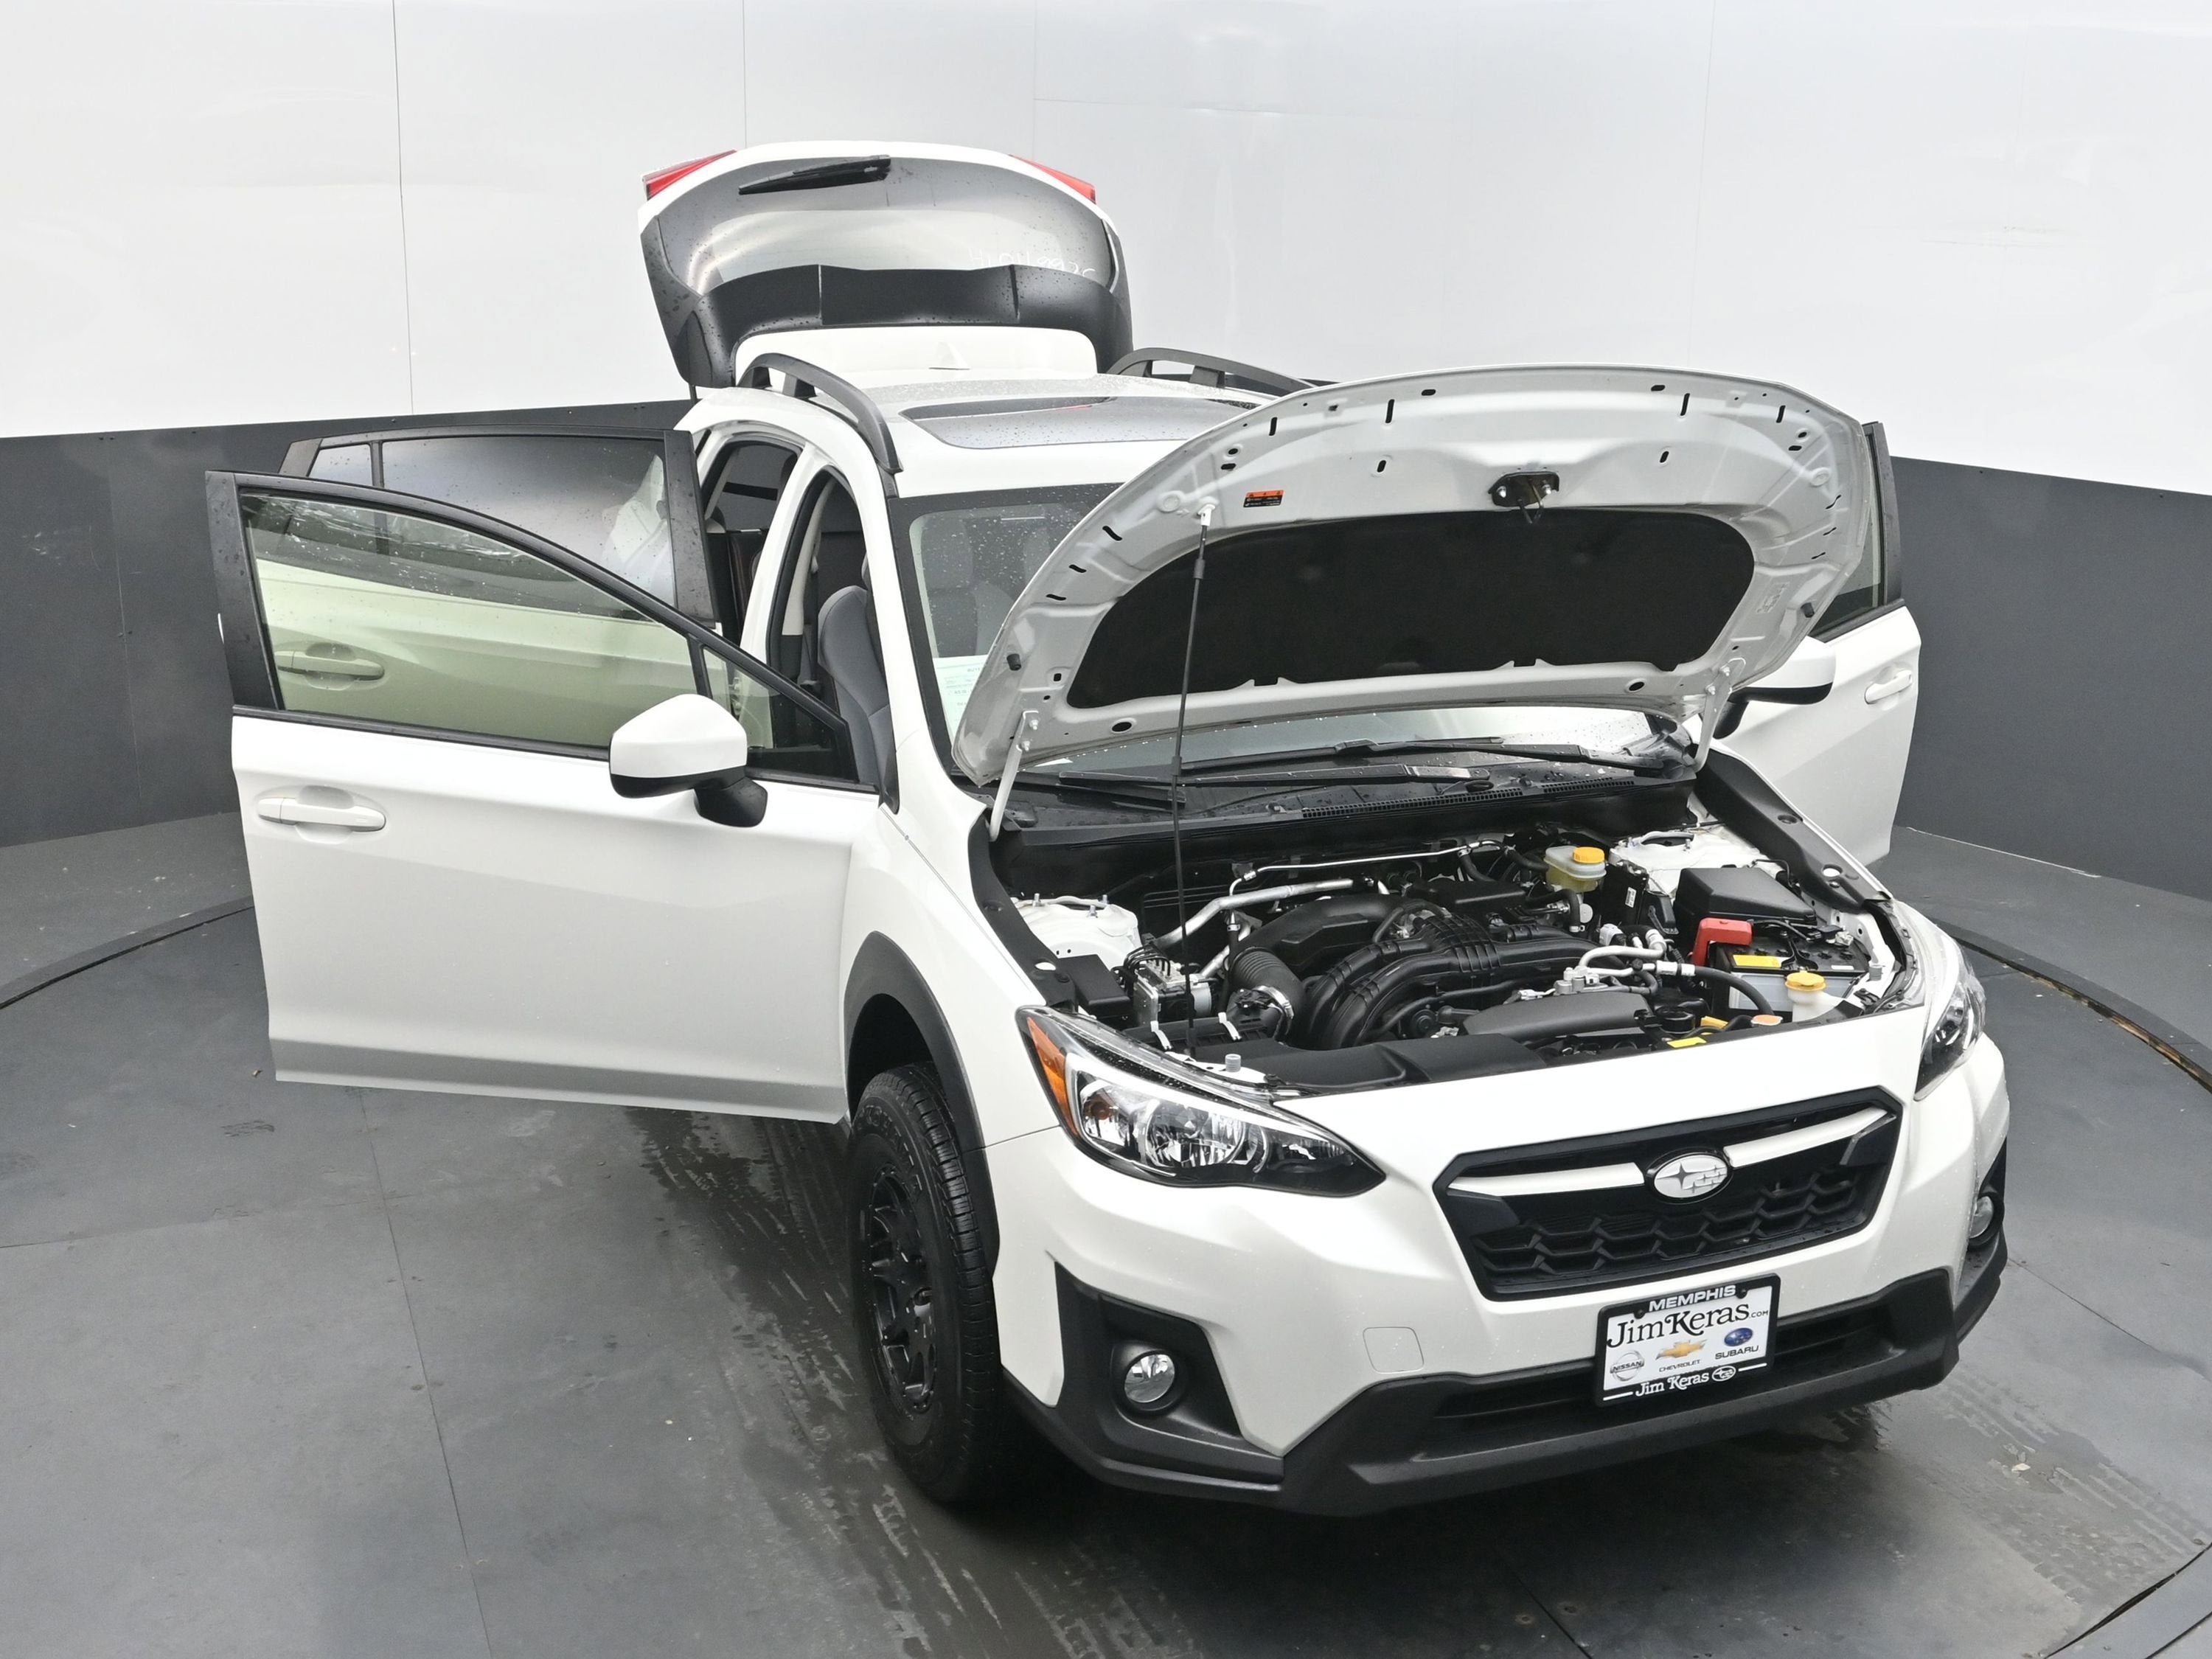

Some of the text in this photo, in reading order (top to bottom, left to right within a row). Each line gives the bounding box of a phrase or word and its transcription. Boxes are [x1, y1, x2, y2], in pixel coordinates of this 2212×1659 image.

[1648, 1284, 1736, 1312] MEMPHIS
[1714, 1344, 1760, 1360] SUBARU
[1612, 1360, 1642, 1372] NISSAN
[1658, 1359, 1701, 1373] CHEVROLET
[1635, 1372, 1710, 1397] Jim Keras
